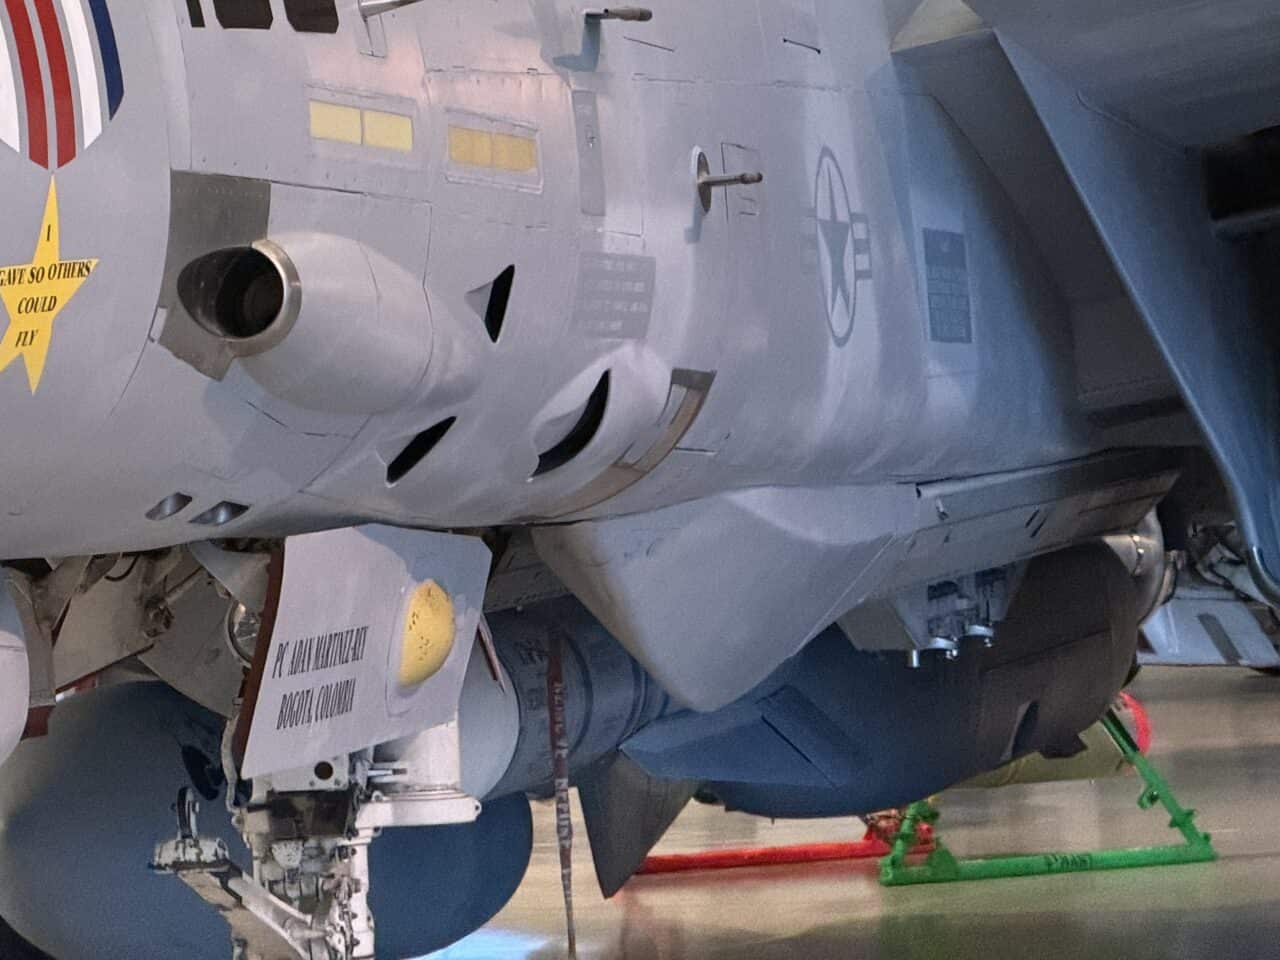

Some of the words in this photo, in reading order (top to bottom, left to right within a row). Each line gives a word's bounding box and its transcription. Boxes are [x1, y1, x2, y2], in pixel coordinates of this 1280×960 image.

[46, 224, 51, 242] I
[27, 266, 45, 285] SO
[47, 260, 93, 281] OTHERS
[17, 295, 57, 314] COULD
[15, 329, 39, 348] FLY
[314, 679, 357, 722] COLOMBIA
